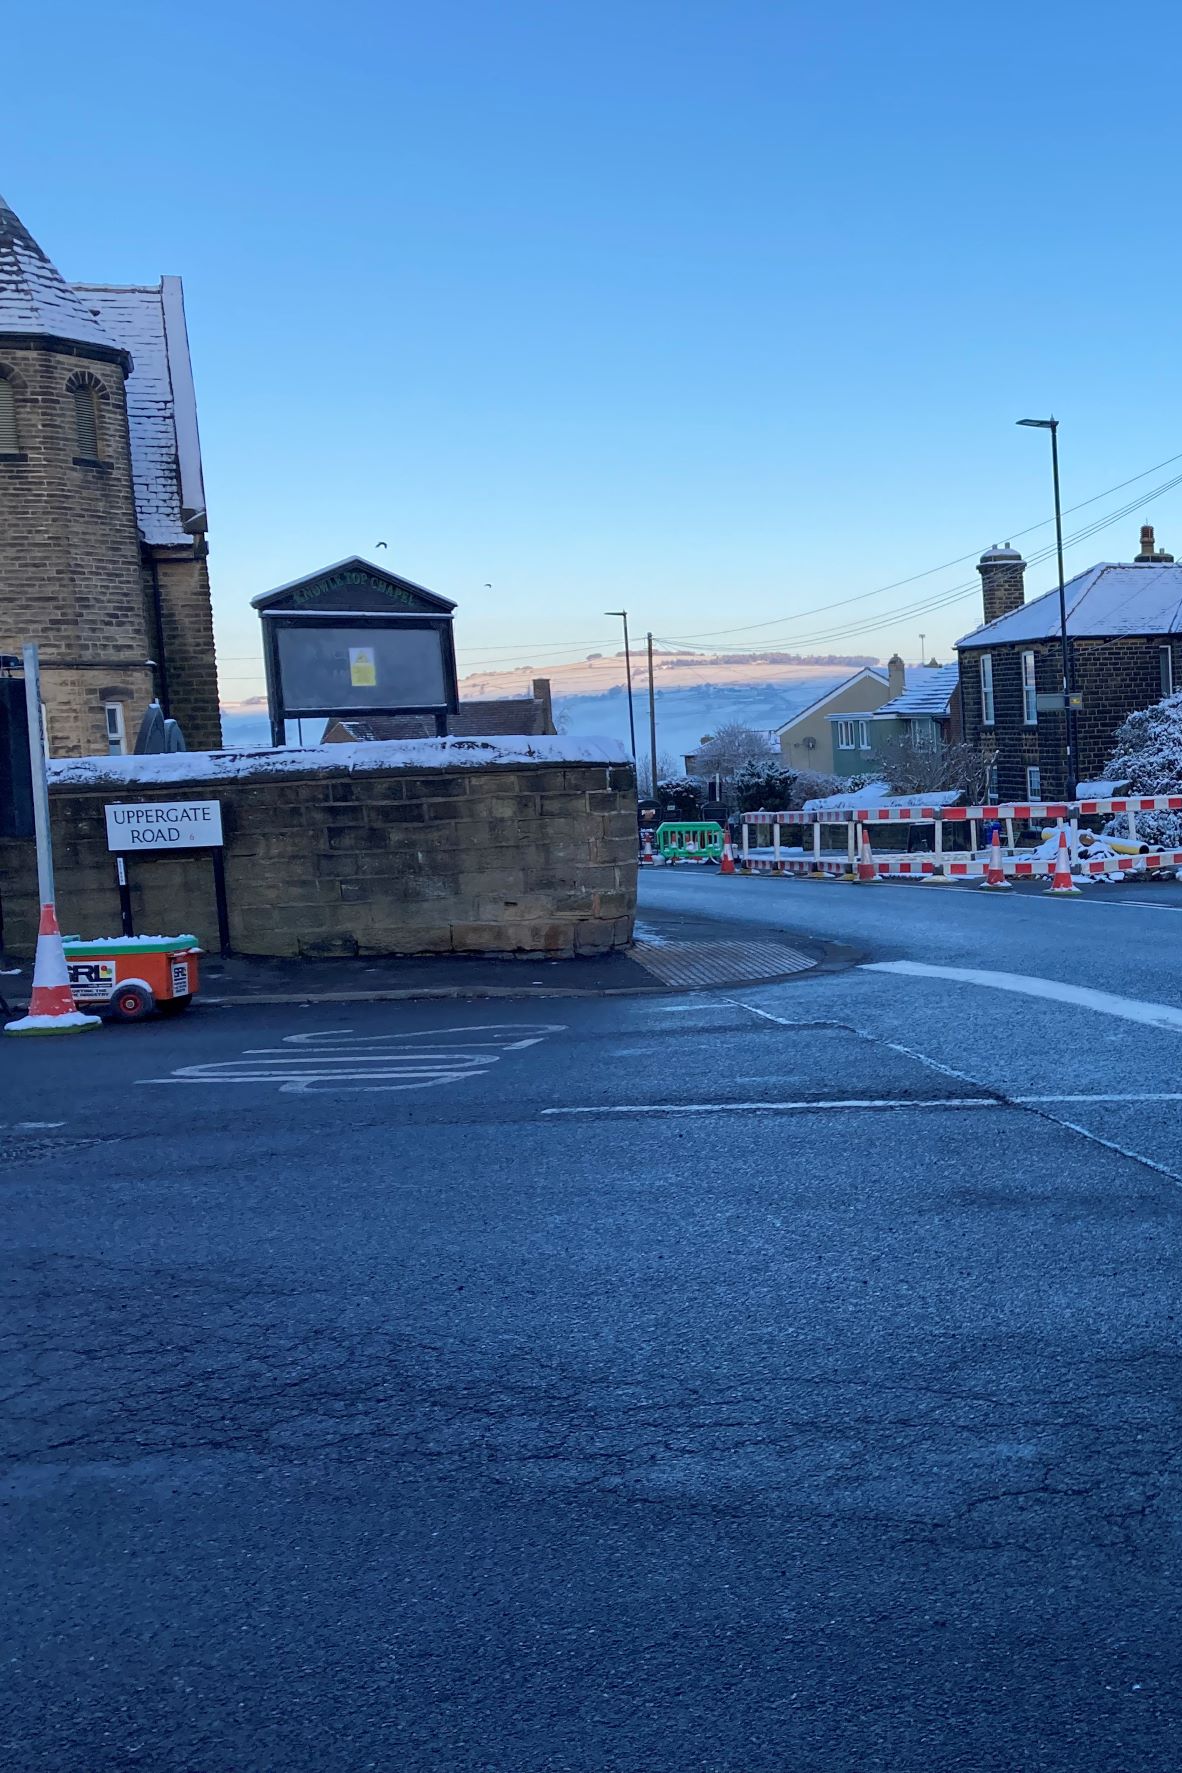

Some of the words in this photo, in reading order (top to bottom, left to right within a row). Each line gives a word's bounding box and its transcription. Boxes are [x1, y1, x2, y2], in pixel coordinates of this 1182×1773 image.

[345, 571, 368, 586] TOP
[370, 576, 417, 606] CHAPEL
[113, 806, 212, 825] UPPERGATE
[130, 827, 180, 844] ROAD
